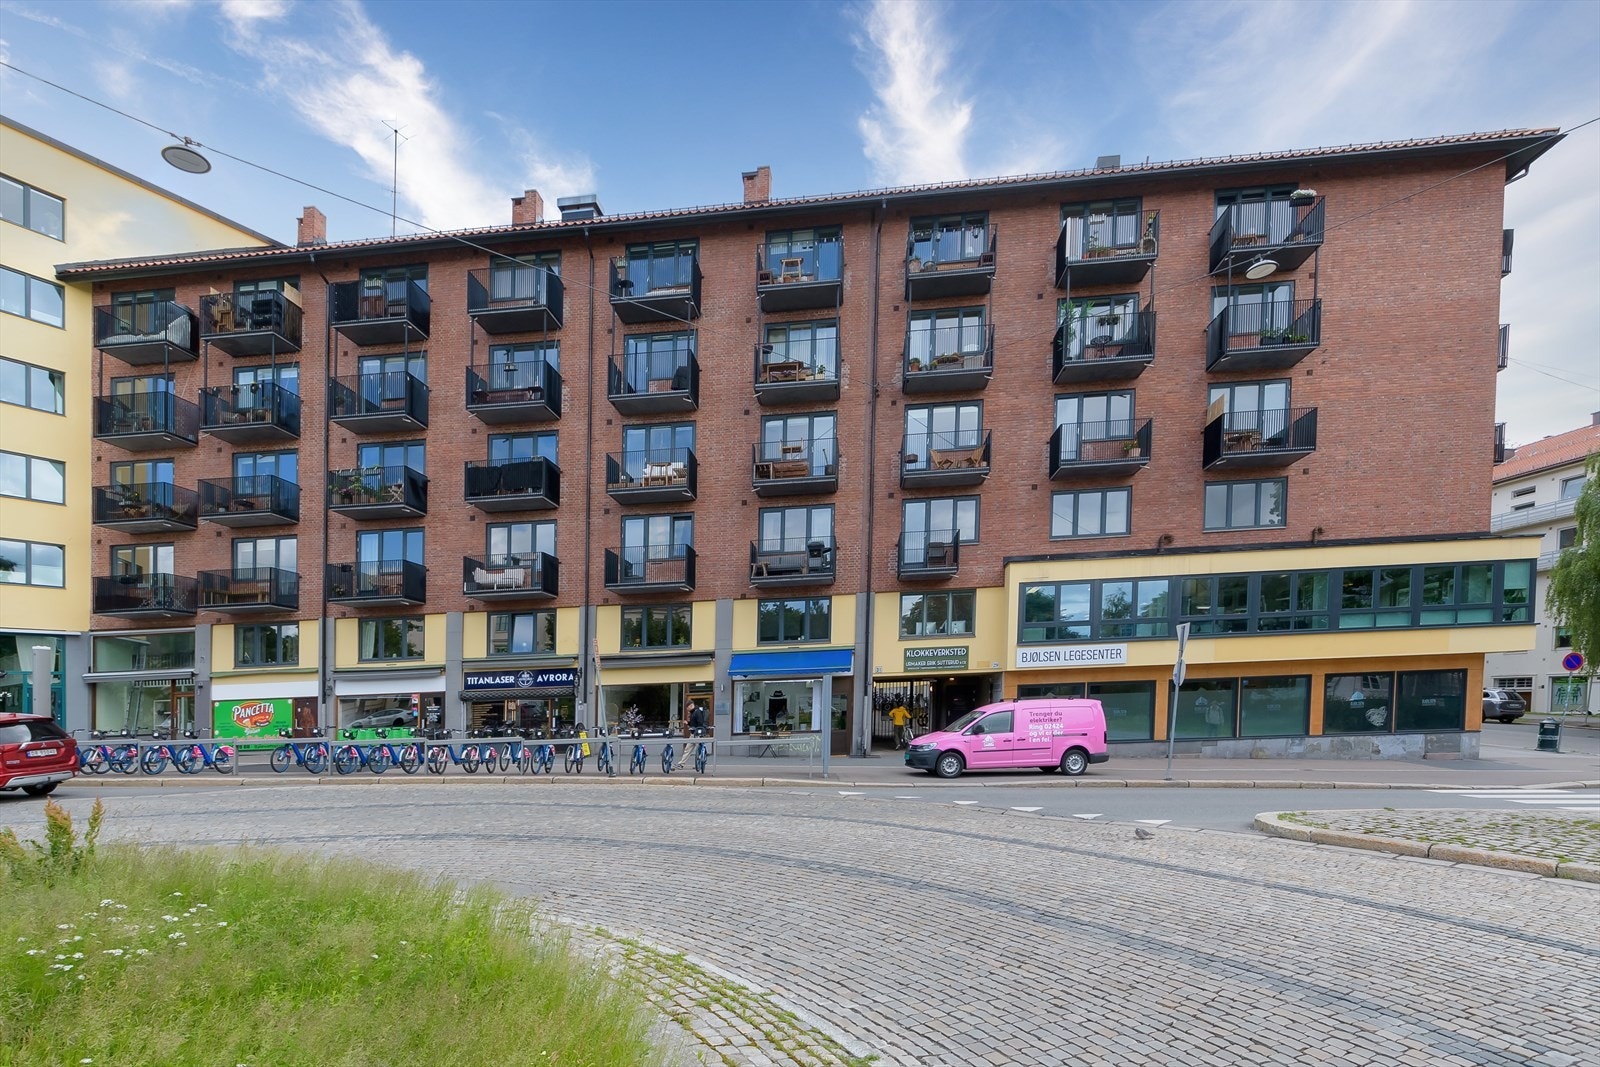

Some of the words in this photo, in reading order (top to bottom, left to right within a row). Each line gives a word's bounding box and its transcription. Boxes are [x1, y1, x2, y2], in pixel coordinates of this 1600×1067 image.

[906, 648, 966, 657] KLOKKEVERKSTED
[1021, 651, 1060, 662] BJØLSEN
[1063, 649, 1112, 661] LEGESENTER
[467, 676, 514, 684] TITANLASER
[537, 674, 573, 682] AVRORA
[232, 703, 274, 720] PANCETTA
